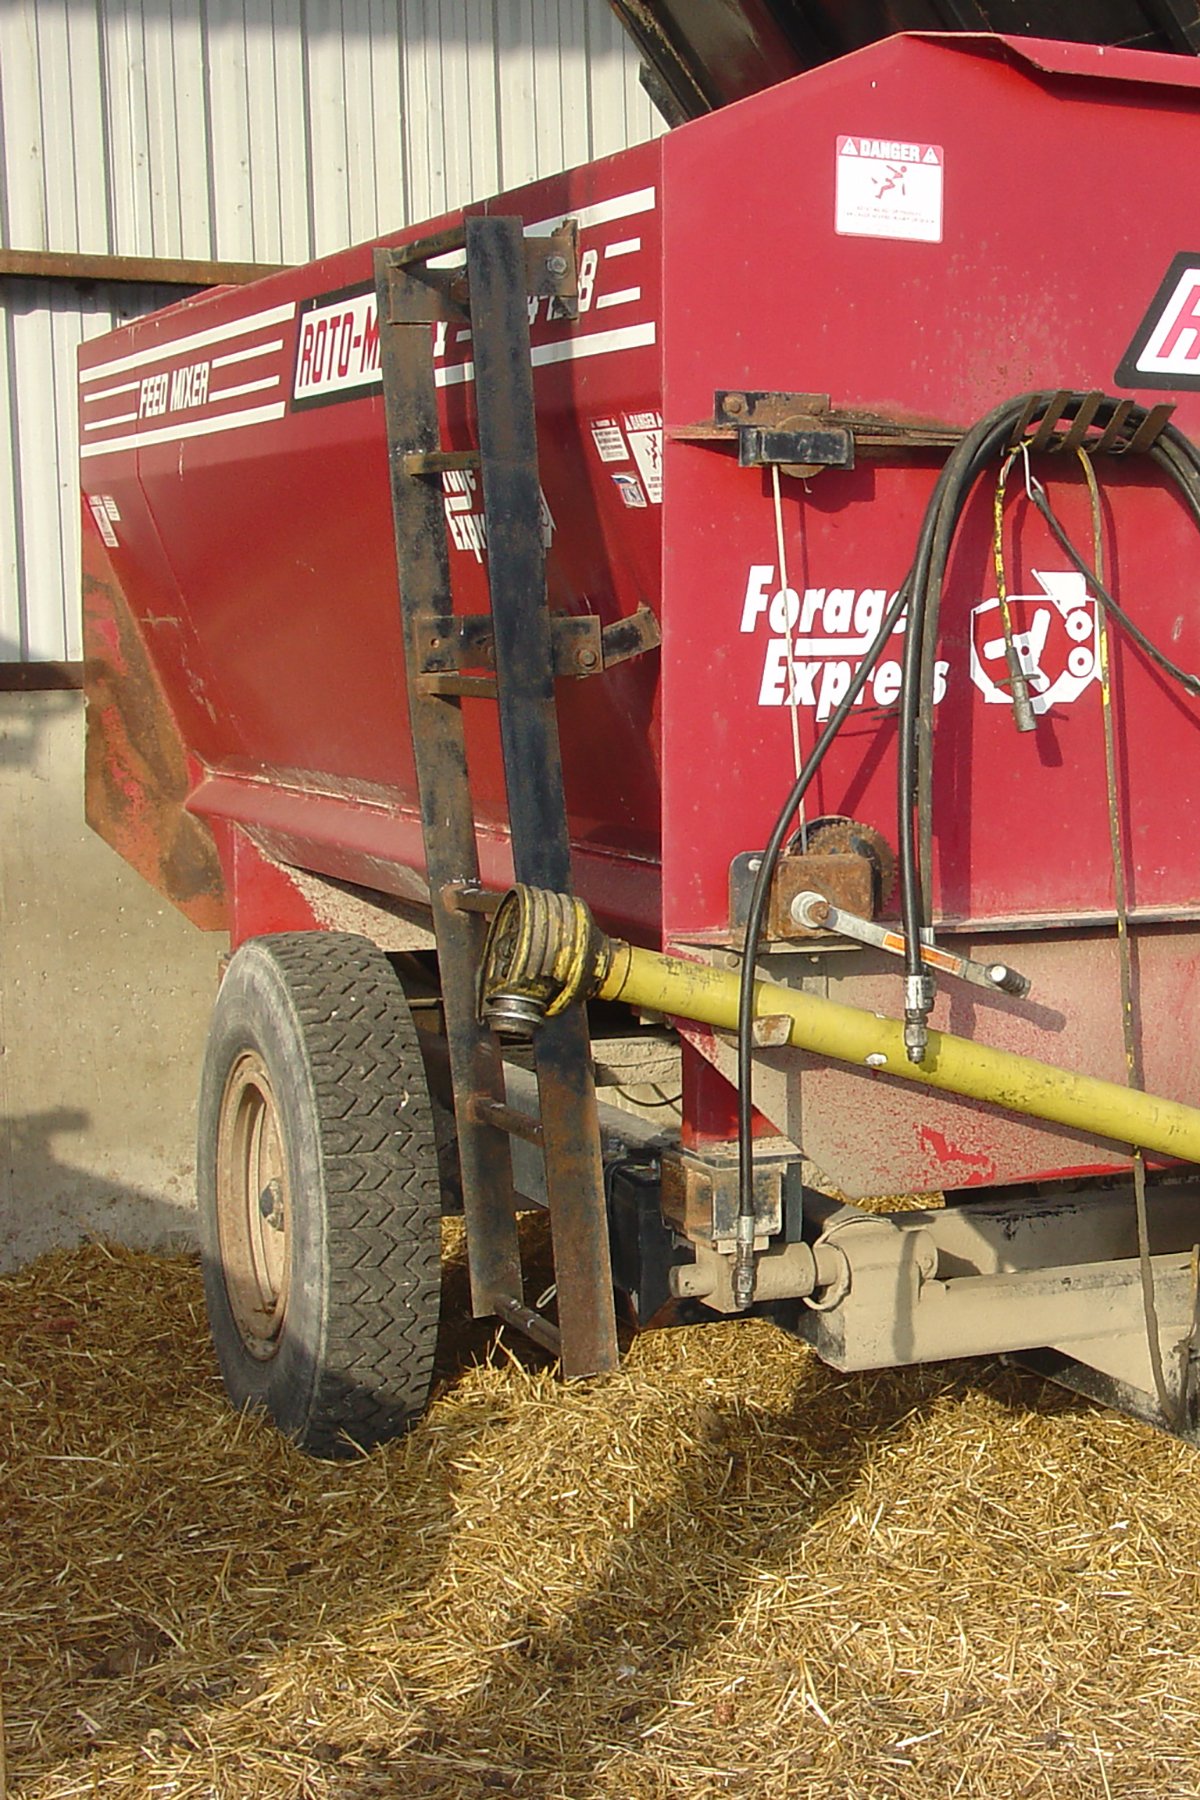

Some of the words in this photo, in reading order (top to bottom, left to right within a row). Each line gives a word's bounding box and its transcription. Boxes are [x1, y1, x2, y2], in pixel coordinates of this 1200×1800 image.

[859, 140, 921, 163] DANGER
[298, 305, 382, 388] ROTO-M
[139, 372, 169, 419] FEED
[169, 361, 210, 412] MIXER
[758, 638, 950, 722] Expres
